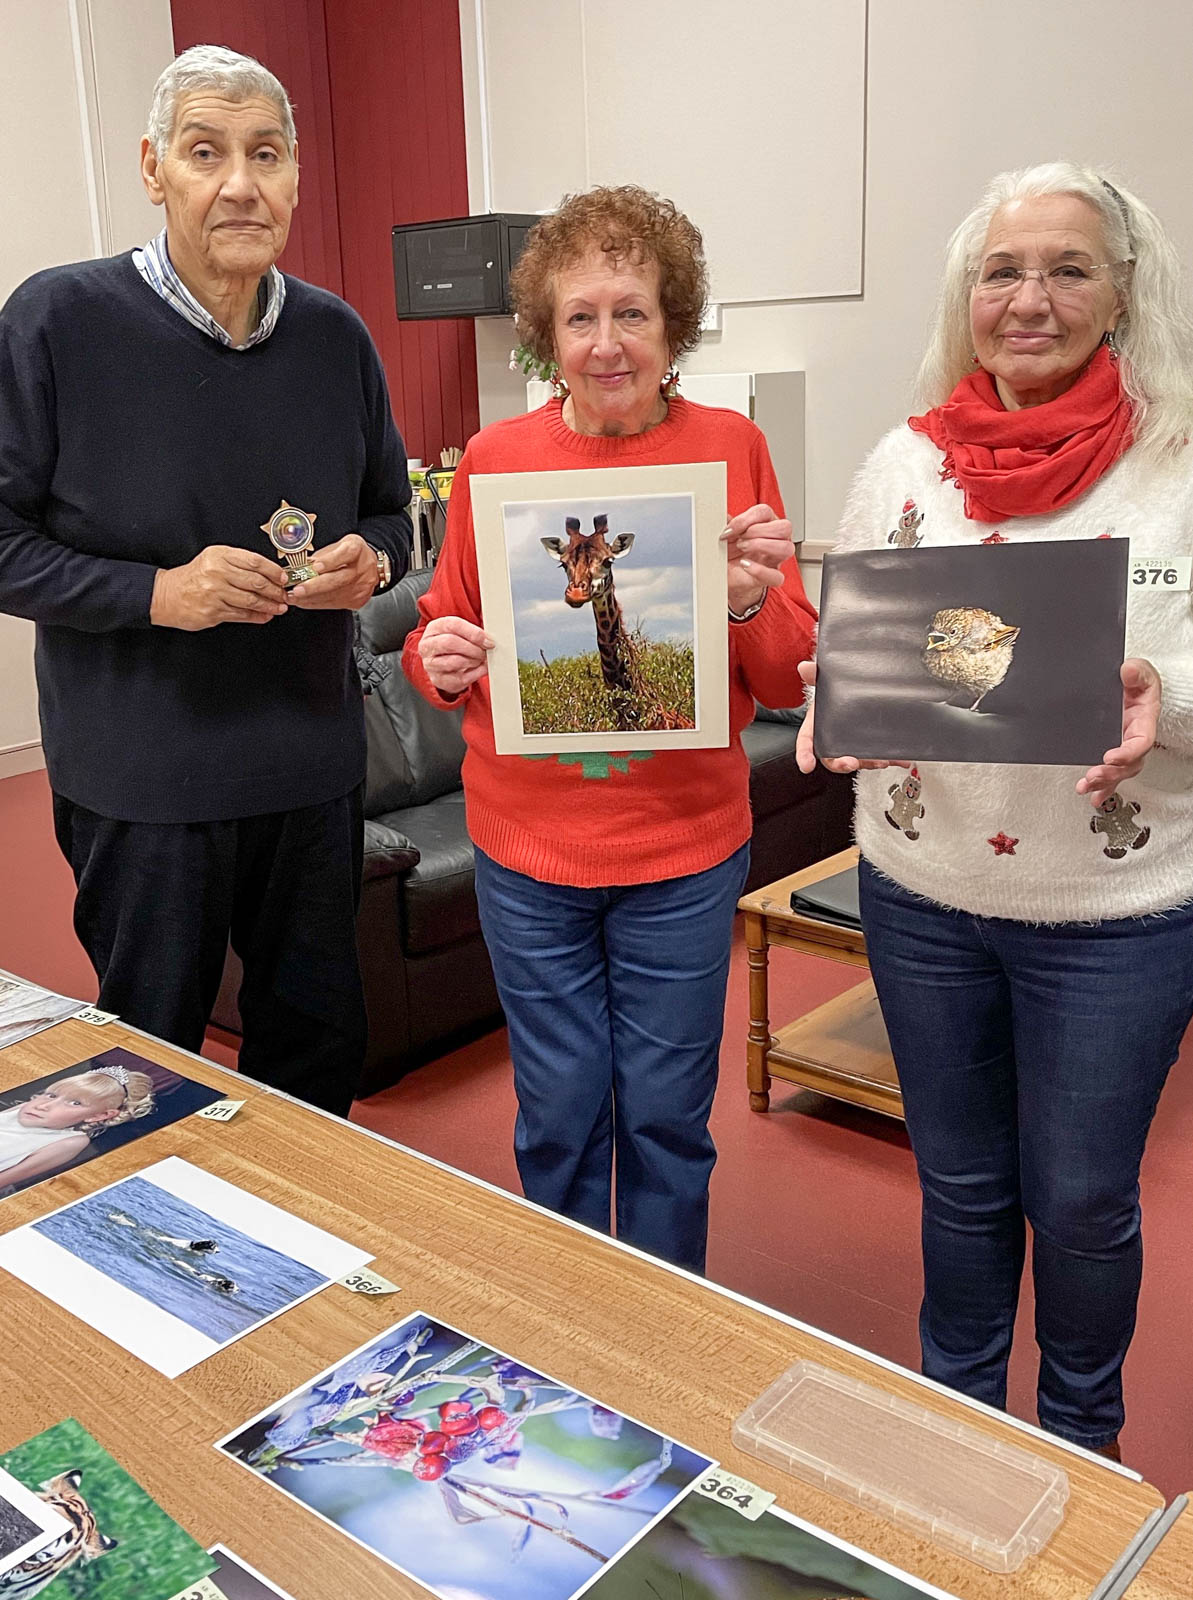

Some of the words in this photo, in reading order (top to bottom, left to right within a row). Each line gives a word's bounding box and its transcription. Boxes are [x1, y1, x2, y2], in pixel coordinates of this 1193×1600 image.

[1132, 569, 1178, 585] 376
[79, 1012, 106, 1023] 379
[204, 1107, 232, 1117] 371
[700, 1478, 753, 1509] 364
